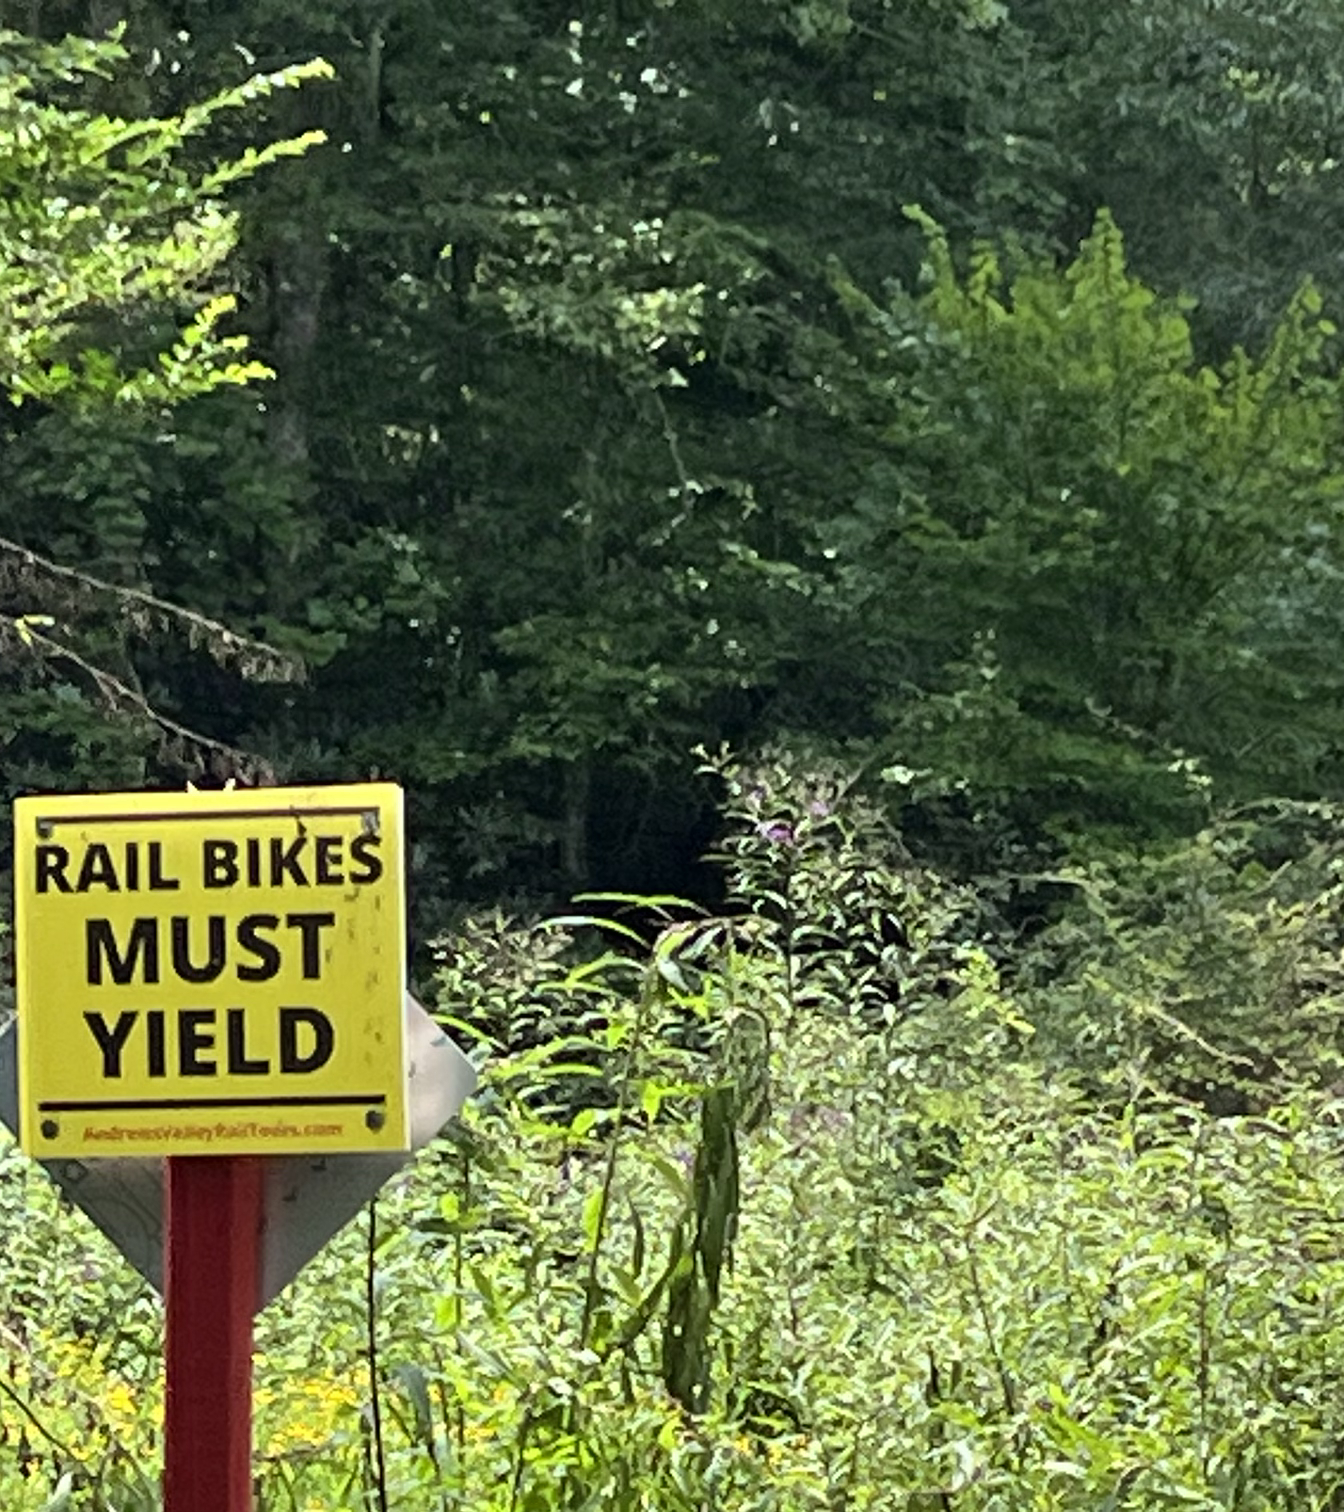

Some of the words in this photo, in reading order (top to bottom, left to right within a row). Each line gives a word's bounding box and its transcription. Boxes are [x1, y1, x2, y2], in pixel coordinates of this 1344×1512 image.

[35, 842, 180, 894] RAIL
[203, 834, 383, 889] BIKES
[85, 912, 336, 986] MUST
[83, 1007, 335, 1079] YIELD
